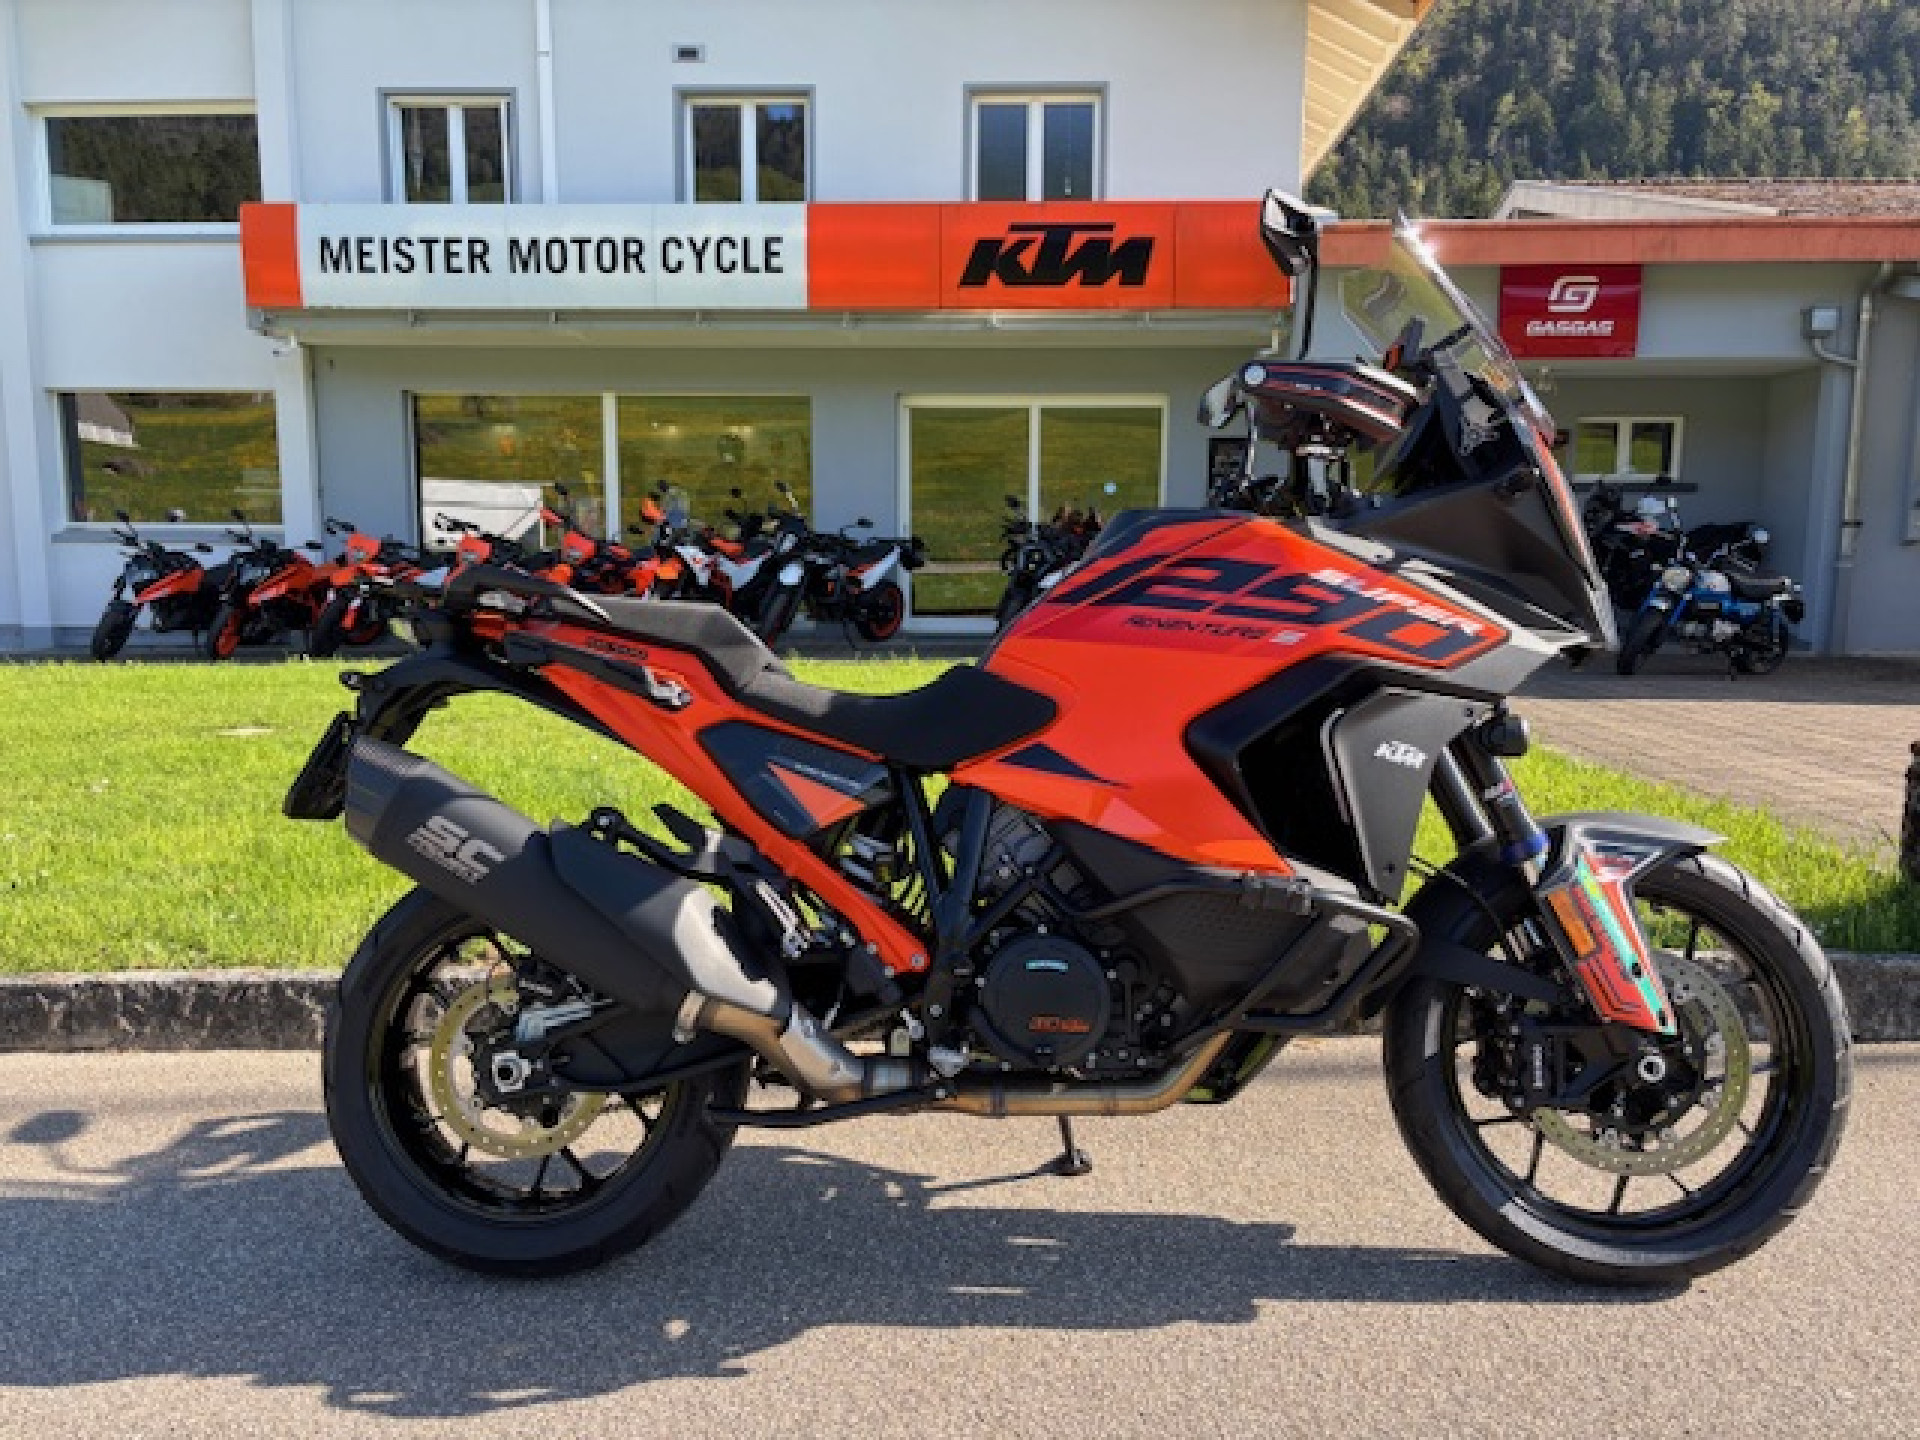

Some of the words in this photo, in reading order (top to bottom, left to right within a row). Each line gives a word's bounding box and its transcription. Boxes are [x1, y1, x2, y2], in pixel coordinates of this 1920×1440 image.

[319, 236, 490, 274] MEISTER
[509, 237, 646, 274] MOTOR
[661, 236, 784, 274] CYCLE
[959, 222, 1155, 287] KTM
[1526, 320, 1614, 336] GASGAS
[1126, 615, 1268, 639] ADVENTURE
[1373, 740, 1428, 768] KTM
